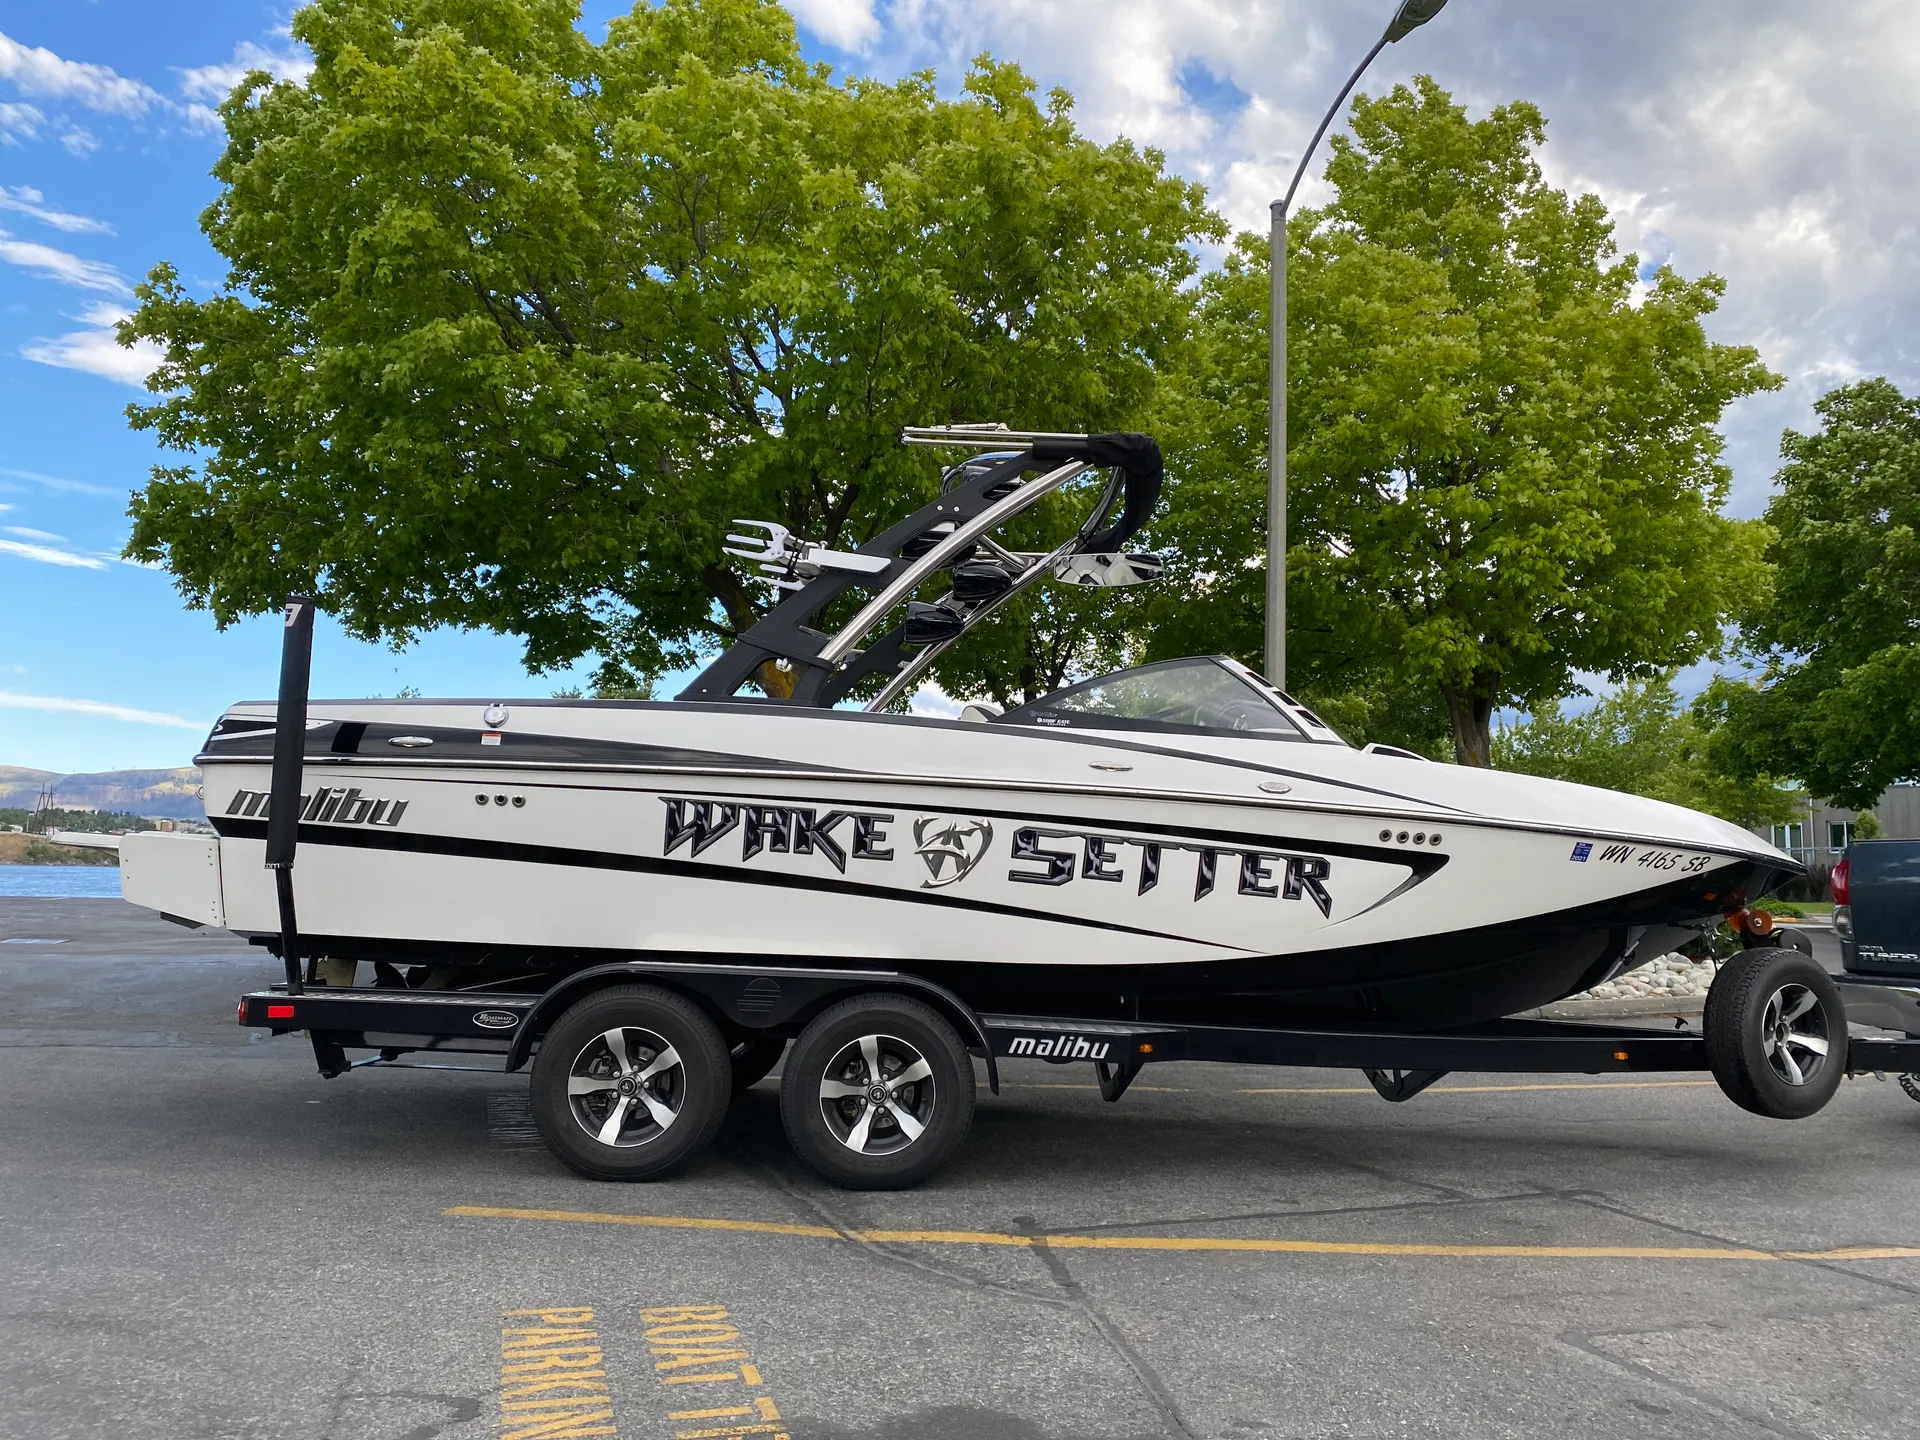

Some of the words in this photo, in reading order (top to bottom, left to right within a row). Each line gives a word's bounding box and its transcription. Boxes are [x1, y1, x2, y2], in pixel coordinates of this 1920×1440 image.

[658, 797, 895, 875] WAKE
[1008, 825, 1333, 919] SETTER
[1599, 845, 1636, 864] WN
[1637, 850, 1684, 870] 4165
[1681, 856, 1711, 872] SB
[1859, 951, 1920, 963] TUNDR
[1008, 1035, 1110, 1059] malibu
[639, 1305, 763, 1386] BOAT
